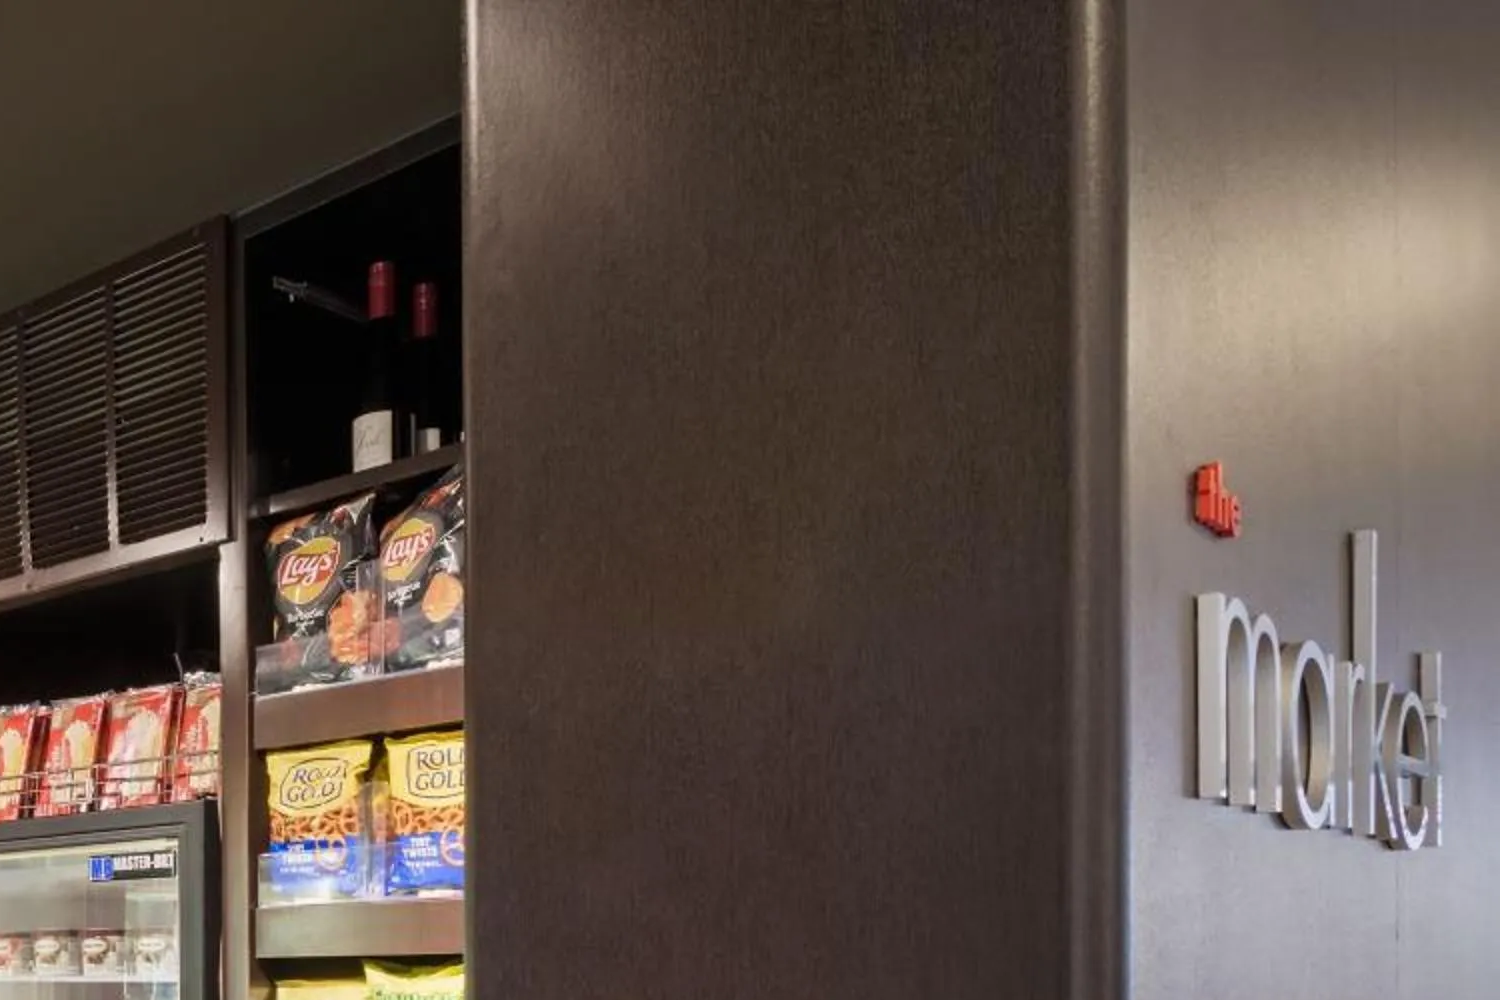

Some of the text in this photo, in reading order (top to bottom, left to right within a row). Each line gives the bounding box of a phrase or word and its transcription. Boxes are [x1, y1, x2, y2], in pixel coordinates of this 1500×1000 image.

[1197, 529, 1447, 851] market
[417, 748, 464, 769] ROL
[415, 770, 464, 791] GOL
